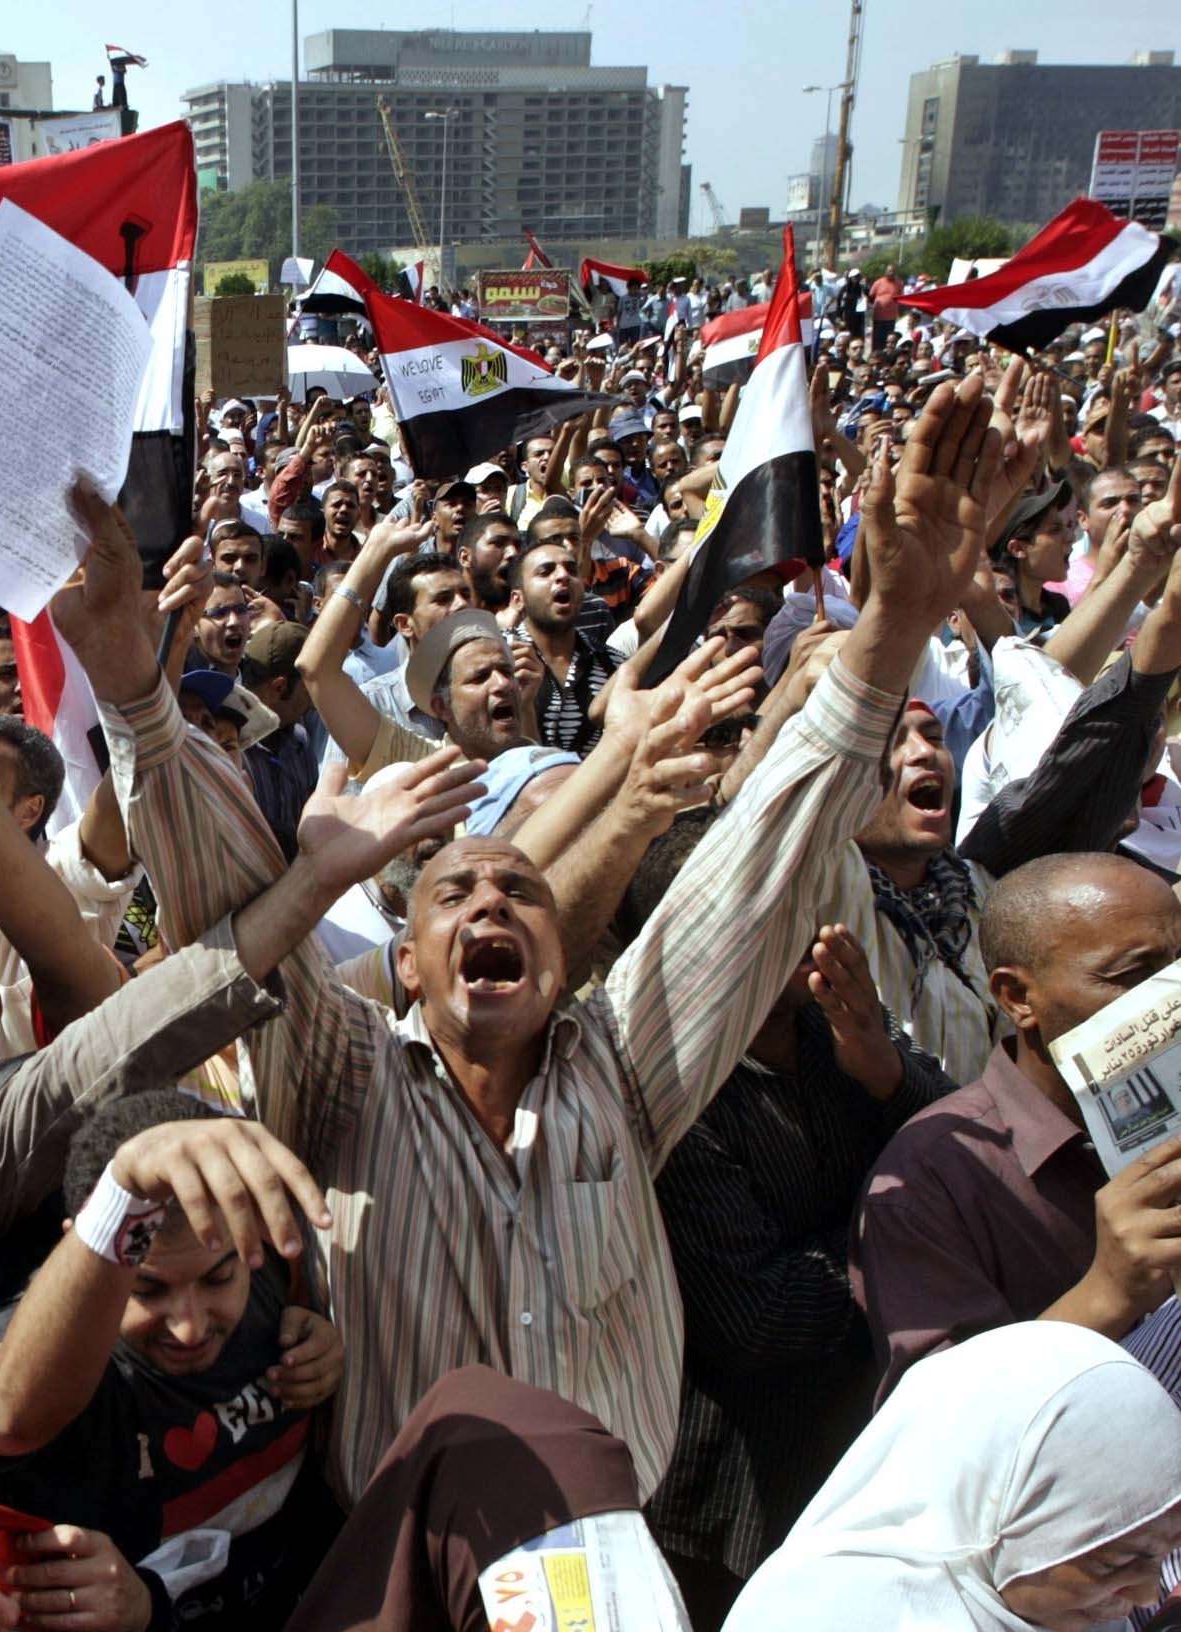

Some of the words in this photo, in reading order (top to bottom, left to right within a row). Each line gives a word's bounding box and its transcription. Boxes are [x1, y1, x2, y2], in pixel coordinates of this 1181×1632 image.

[399, 362, 417, 378] WE
[417, 354, 444, 375] LOVE
[1141, 1008, 1160, 1033] قتل
[1103, 1023, 1140, 1054] السادات
[1131, 1031, 1160, 1056] ثورة
